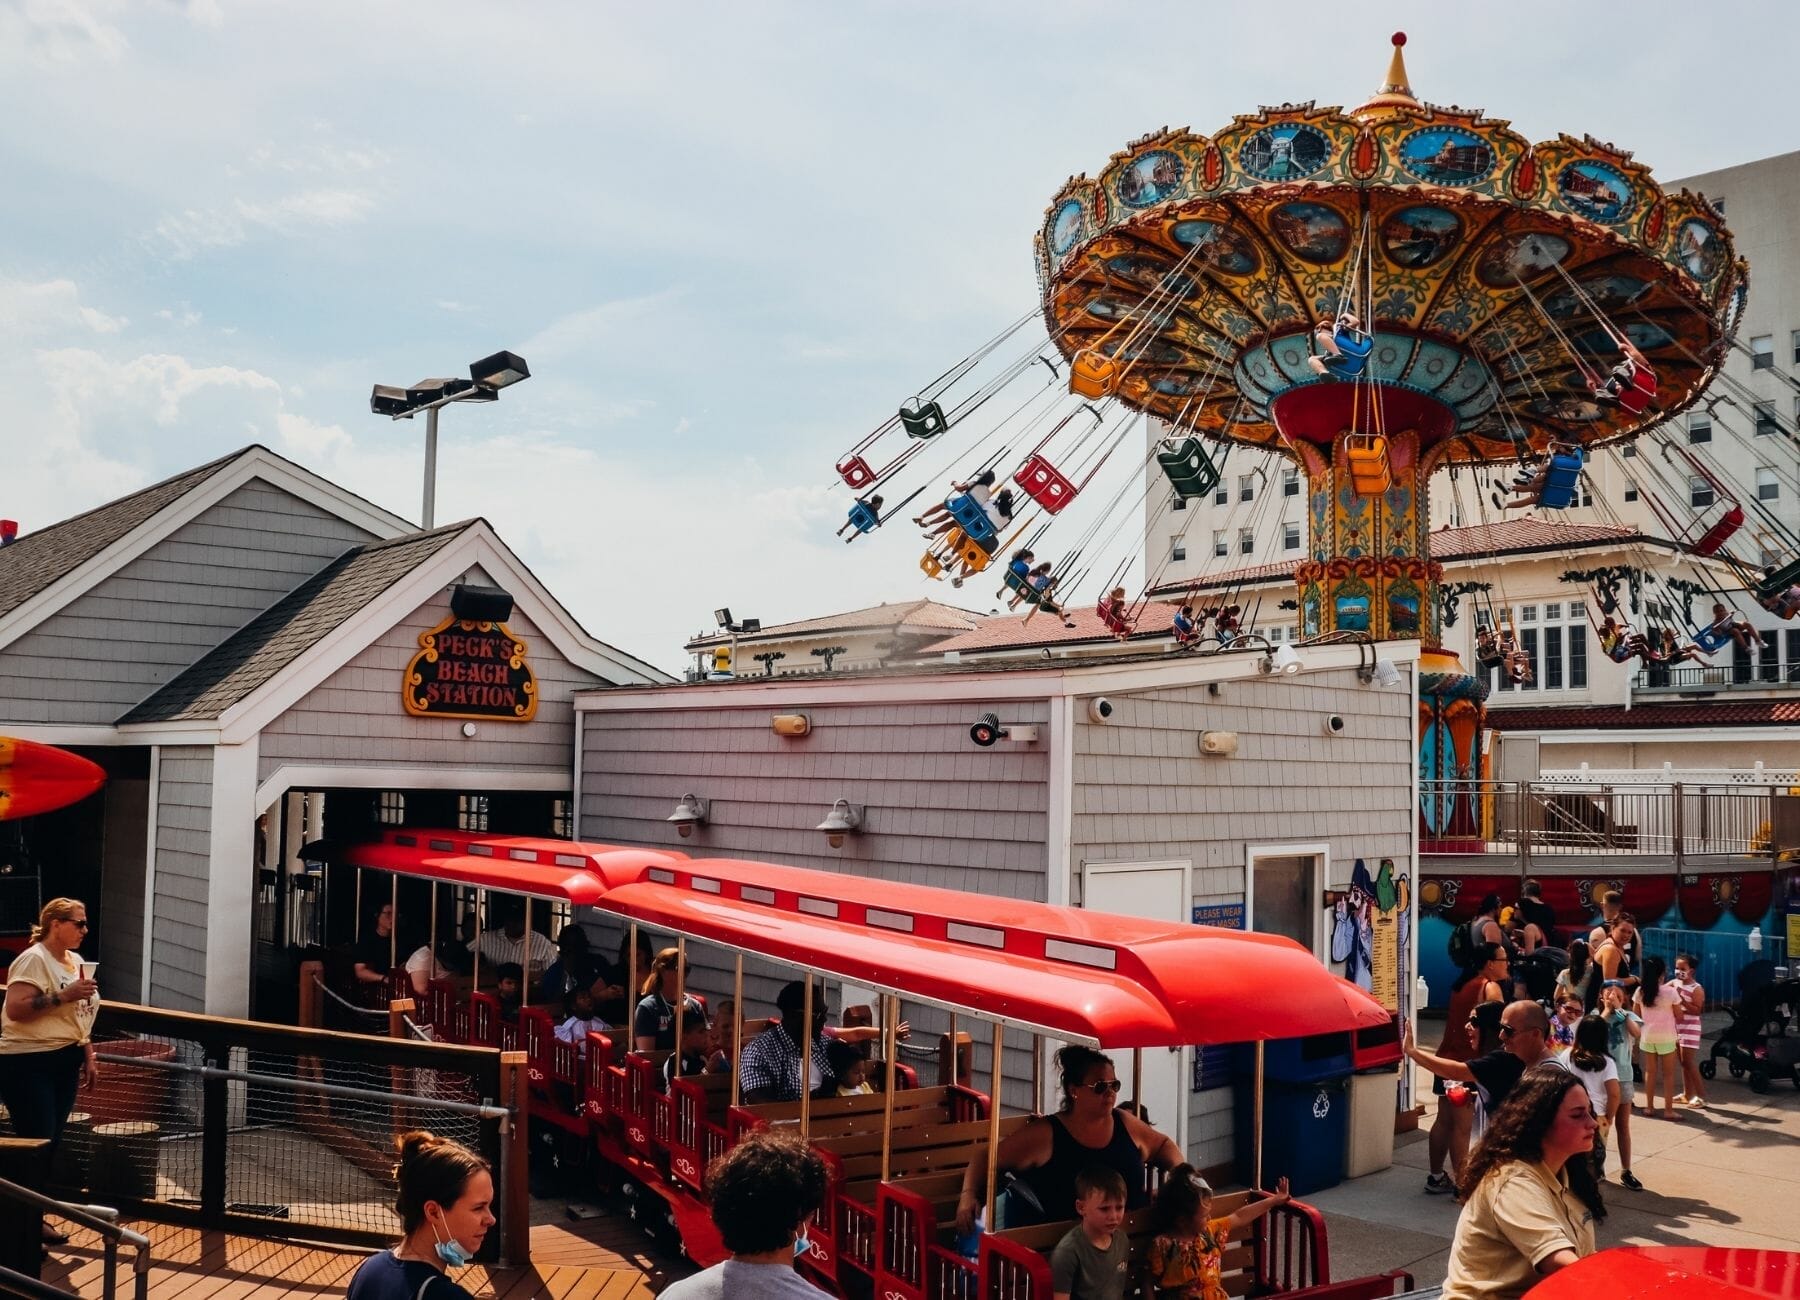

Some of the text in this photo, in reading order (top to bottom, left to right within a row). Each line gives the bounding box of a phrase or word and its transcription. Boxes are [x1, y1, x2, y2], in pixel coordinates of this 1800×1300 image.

[438, 635, 513, 660] PECK'S
[437, 660, 509, 684] BEACH
[426, 682, 517, 707] STATION
[1195, 909, 1220, 919] PLEASE
[1218, 918, 1240, 927] MASKS
